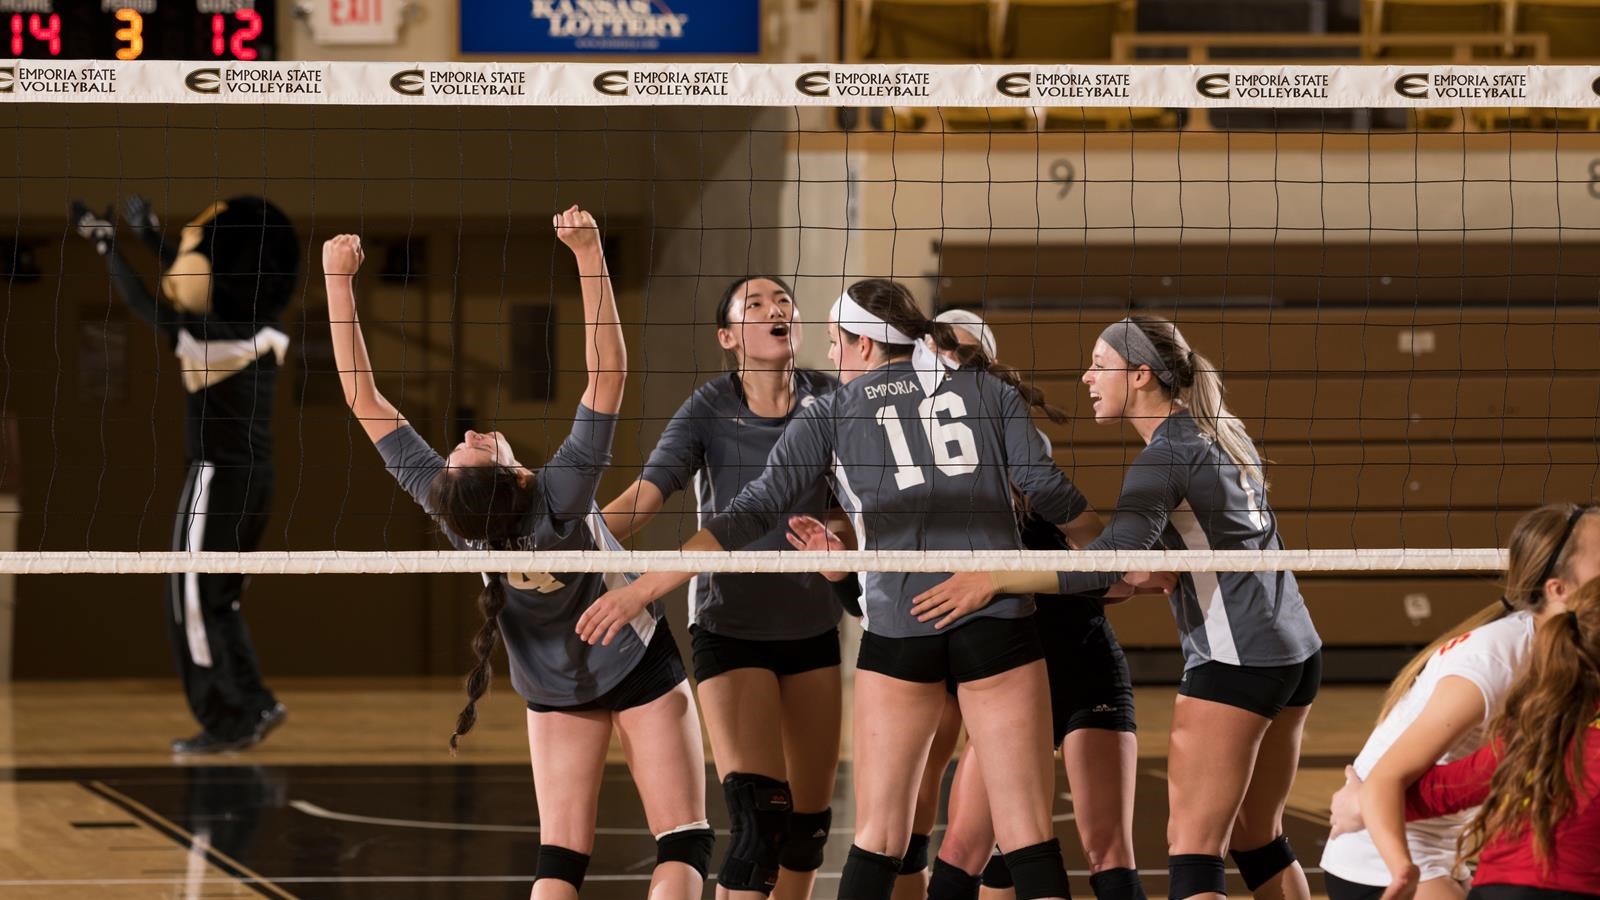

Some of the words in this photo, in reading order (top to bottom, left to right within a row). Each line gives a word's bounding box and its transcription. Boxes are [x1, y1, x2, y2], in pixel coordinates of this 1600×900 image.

[549, 13, 687, 37] LOTTERY
[11, 13, 61, 56] 14
[115, 8, 143, 60] 3
[212, 8, 262, 60] 12
[20, 68, 77, 81] EMPORIA
[82, 68, 116, 81] STATE
[226, 69, 282, 82] EMPORIA
[288, 69, 321, 82] STATE
[431, 71, 486, 84] EMPORIA
[491, 71, 525, 84] STATE
[634, 71, 689, 84] EMPORIA
[695, 71, 728, 84] STATE
[836, 72, 891, 85] EMPORIA
[896, 72, 929, 85] STATE
[1036, 73, 1091, 86] EMPORIA
[1096, 73, 1129, 86] STATE
[1236, 74, 1290, 87] EMPORIA
[1295, 74, 1328, 87] STATE
[1435, 74, 1488, 87] EMPORIA
[1493, 74, 1526, 87] STATE
[21, 81, 115, 93] VOLLEYBALL
[227, 82, 320, 94] VOLLEYBALL
[432, 84, 524, 96] VOLLEYBALL
[635, 84, 727, 96] VOLLEYBALL
[837, 85, 929, 97] VOLLEYBALL
[1037, 86, 1129, 98] VOLLEYBALL
[1237, 87, 1328, 99] VOLLEYBALL
[1436, 87, 1525, 99] VOLLEYBALL
[1049, 158, 1075, 200] 9
[864, 380, 919, 400] EMPORIA
[875, 391, 979, 491] 16
